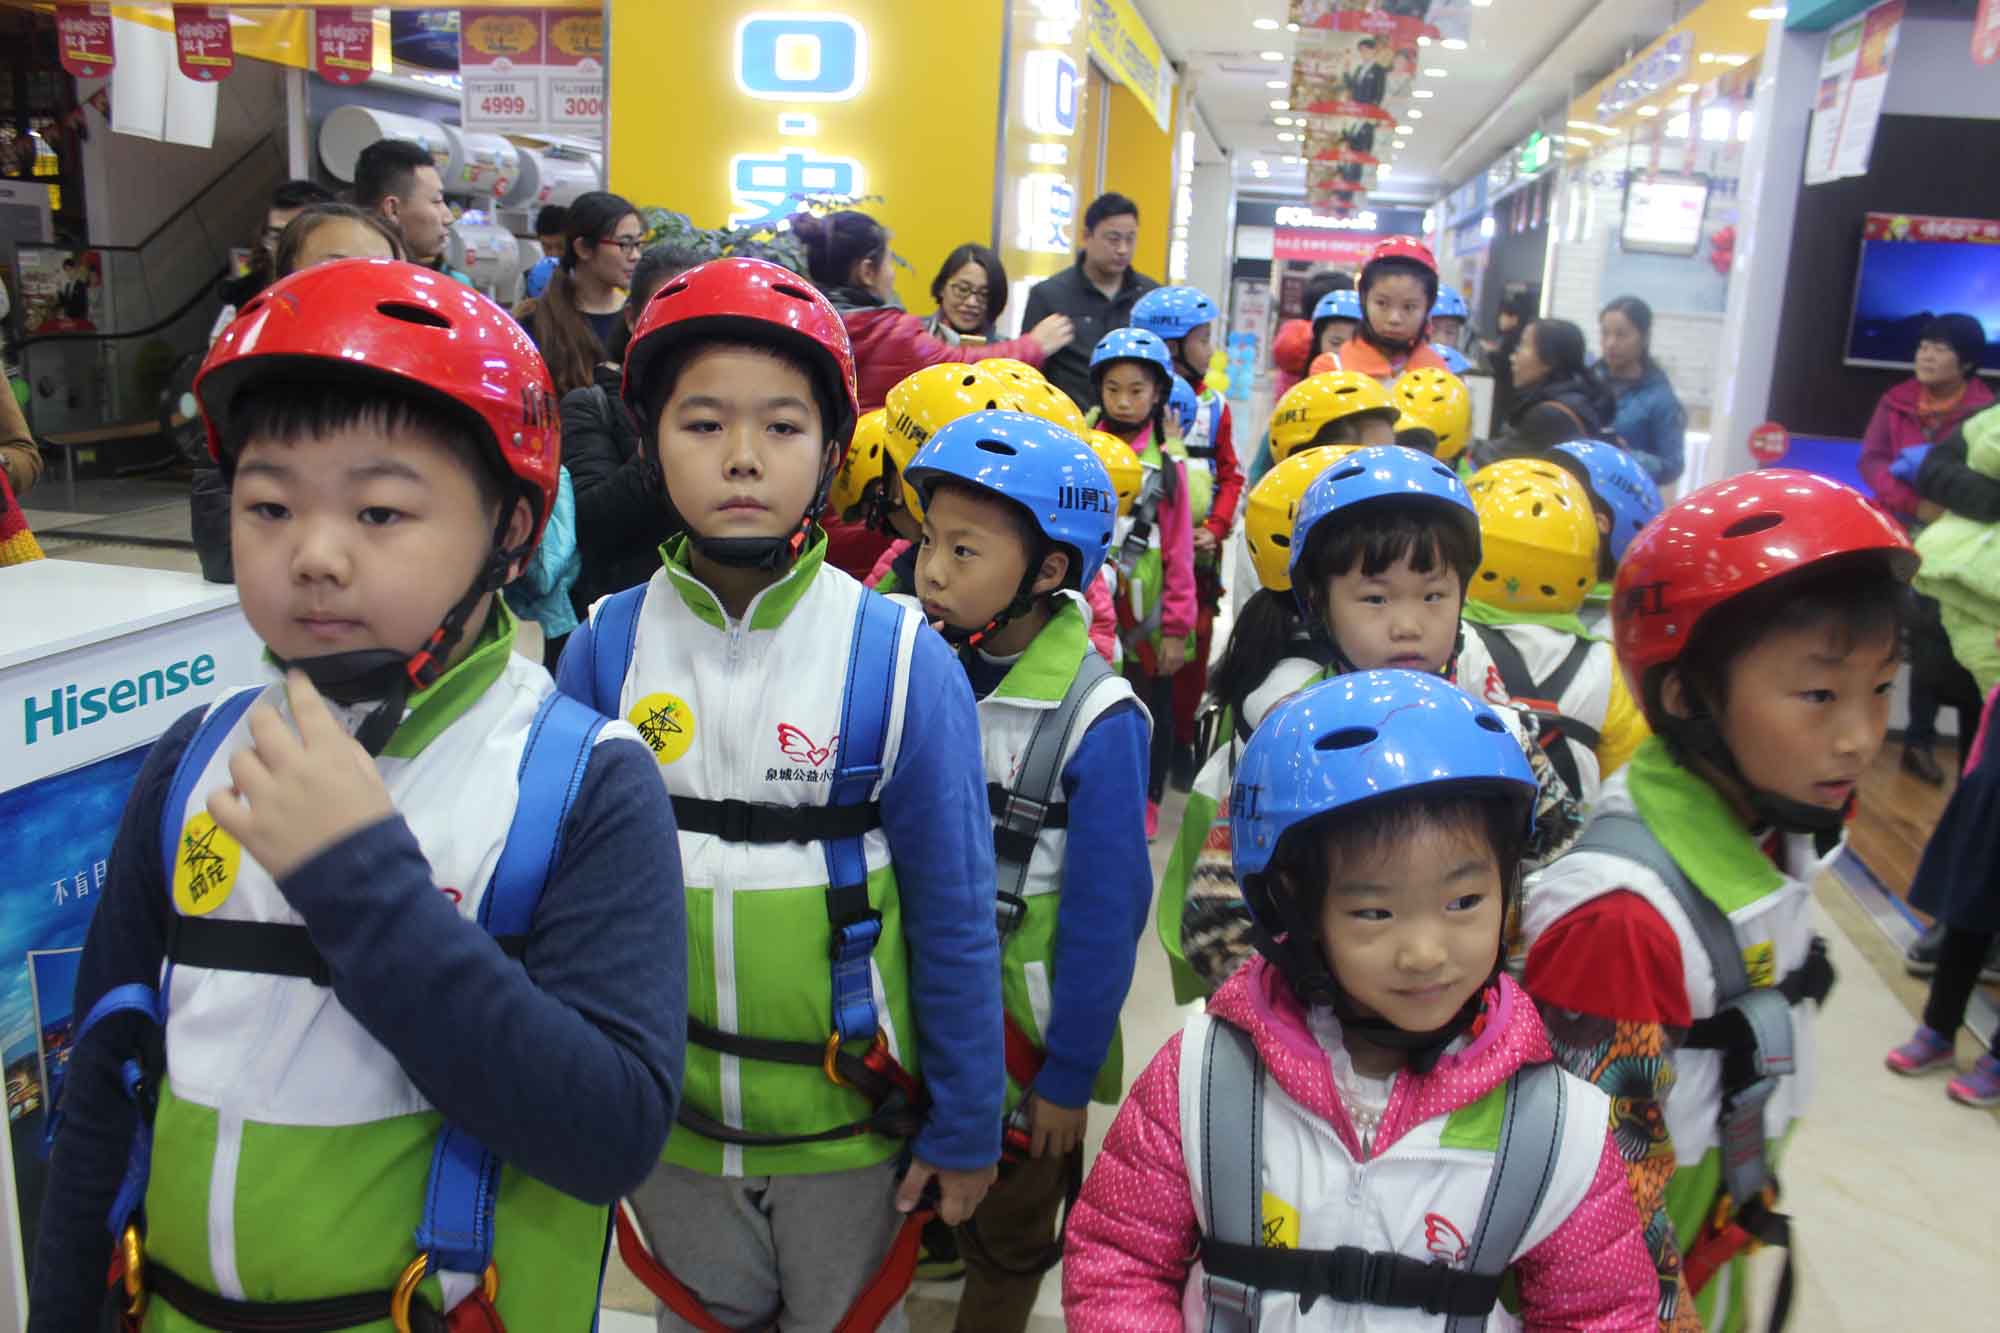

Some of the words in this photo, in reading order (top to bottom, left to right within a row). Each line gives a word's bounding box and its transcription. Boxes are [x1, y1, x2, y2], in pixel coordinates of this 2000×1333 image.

[481, 96, 526, 115] 4999
[25, 654, 216, 745] Hisense
[765, 767, 836, 783] 泉城公益小
